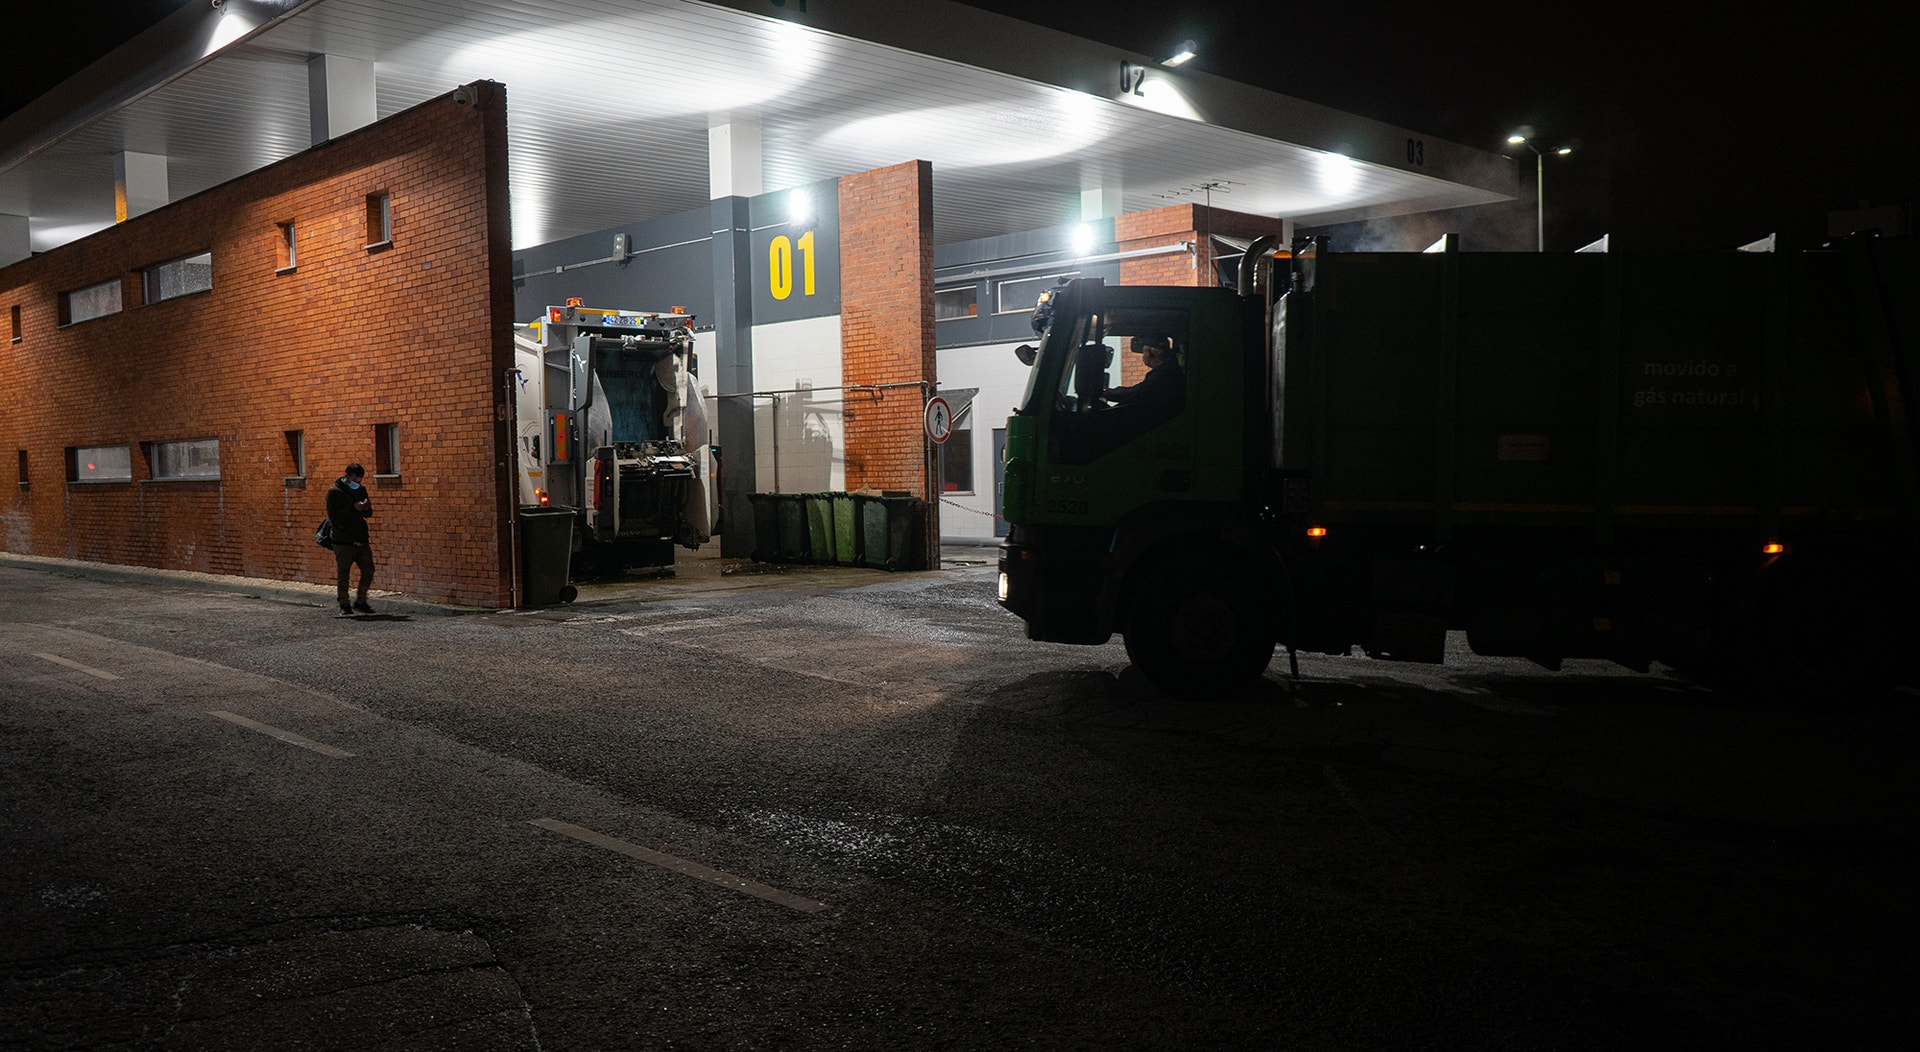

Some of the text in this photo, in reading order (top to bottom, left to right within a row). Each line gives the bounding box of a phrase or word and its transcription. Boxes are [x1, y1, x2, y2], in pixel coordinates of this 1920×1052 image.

[1120, 60, 1145, 97] 02
[1407, 138, 1423, 166] 03
[769, 230, 815, 300] 01
[1644, 359, 1737, 377] movido a
[1634, 386, 1745, 408] gás natural
[1046, 500, 1088, 515] 2520
